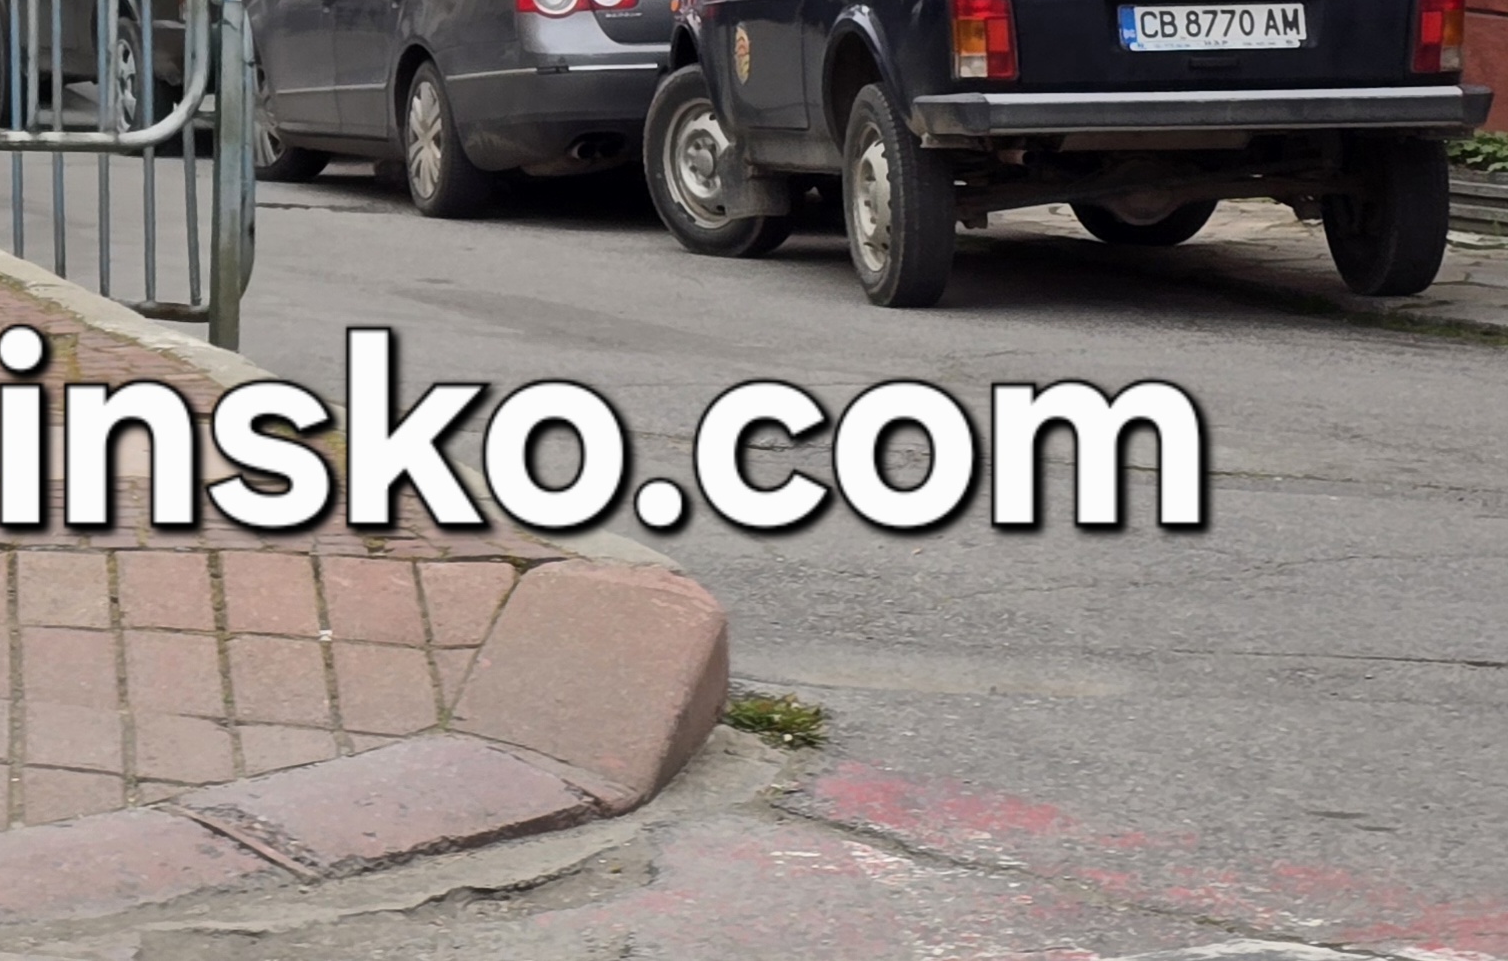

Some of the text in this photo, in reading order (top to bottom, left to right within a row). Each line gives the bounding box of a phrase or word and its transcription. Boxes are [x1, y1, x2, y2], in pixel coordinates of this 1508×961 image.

[1140, 8, 1301, 38] CB 8770 AM
